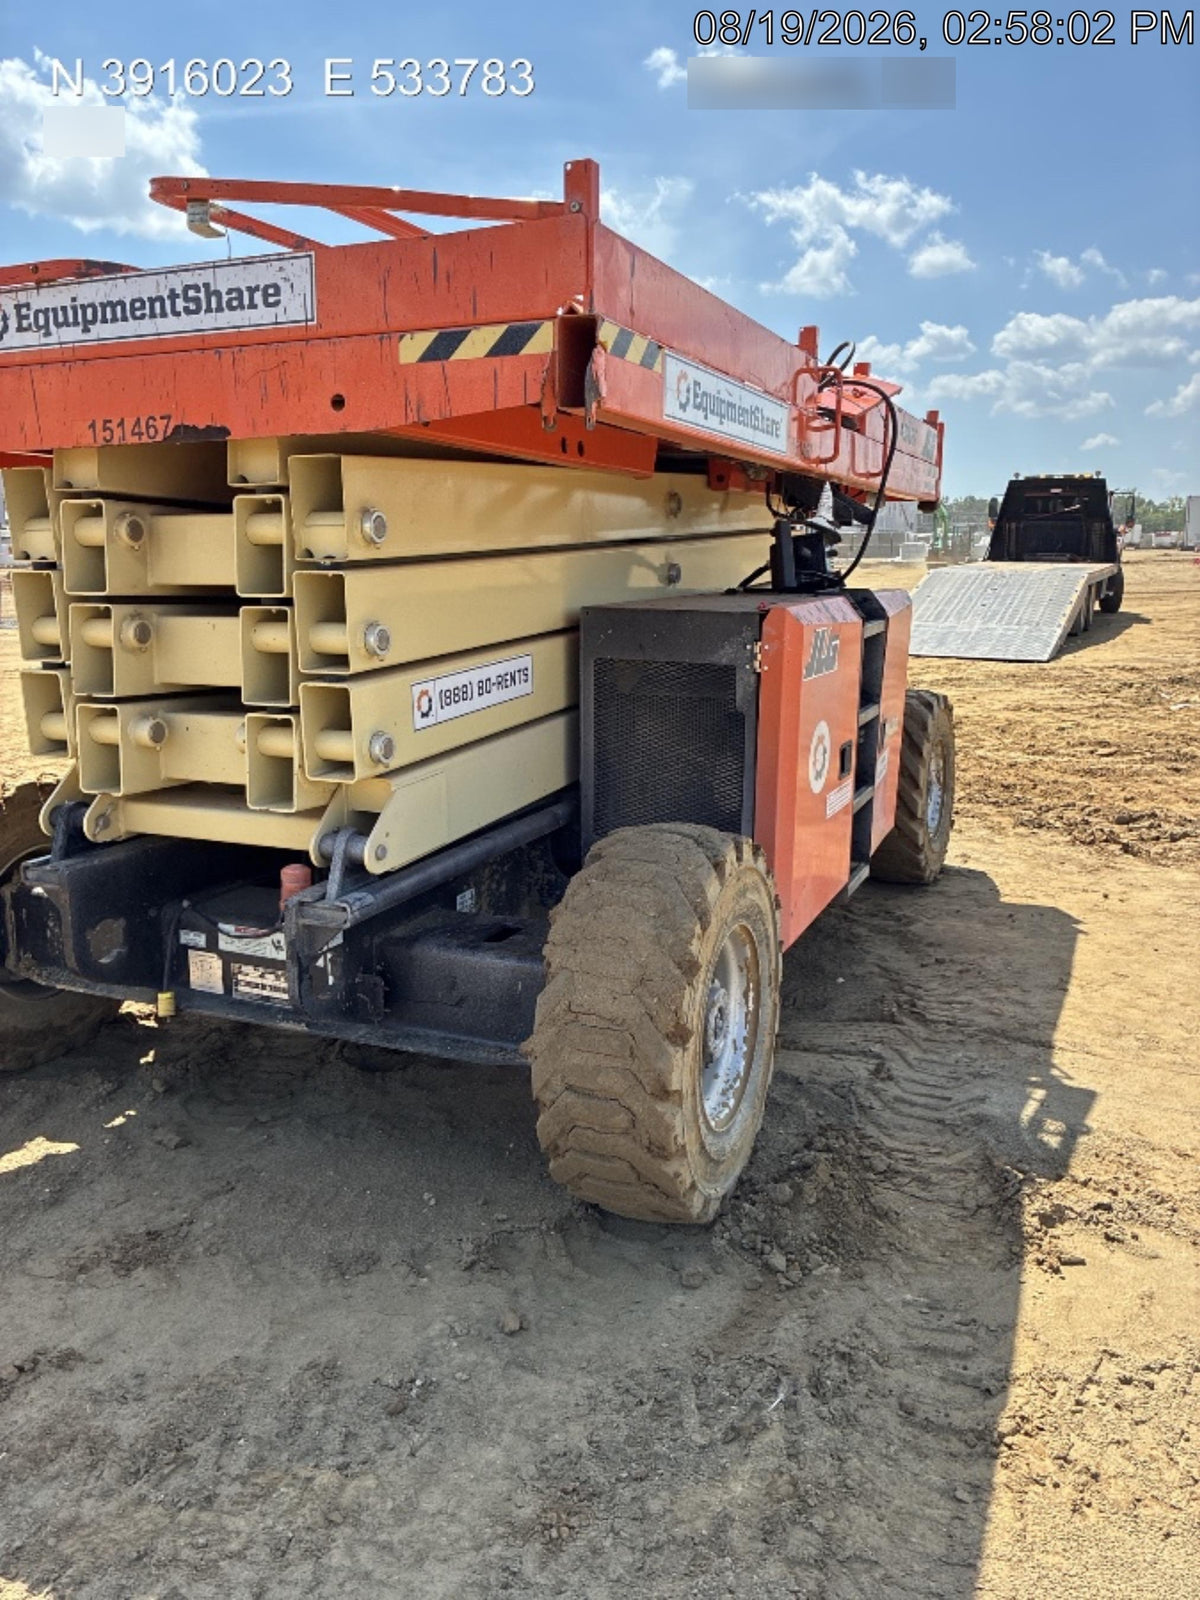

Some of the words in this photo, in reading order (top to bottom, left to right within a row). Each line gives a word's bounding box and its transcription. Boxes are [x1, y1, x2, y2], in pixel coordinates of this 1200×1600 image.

[14, 282, 282, 338] EquipmentShare
[88, 414, 172, 444] 151467
[693, 379, 780, 439] EquipmentShare
[438, 680, 474, 710] (888)
